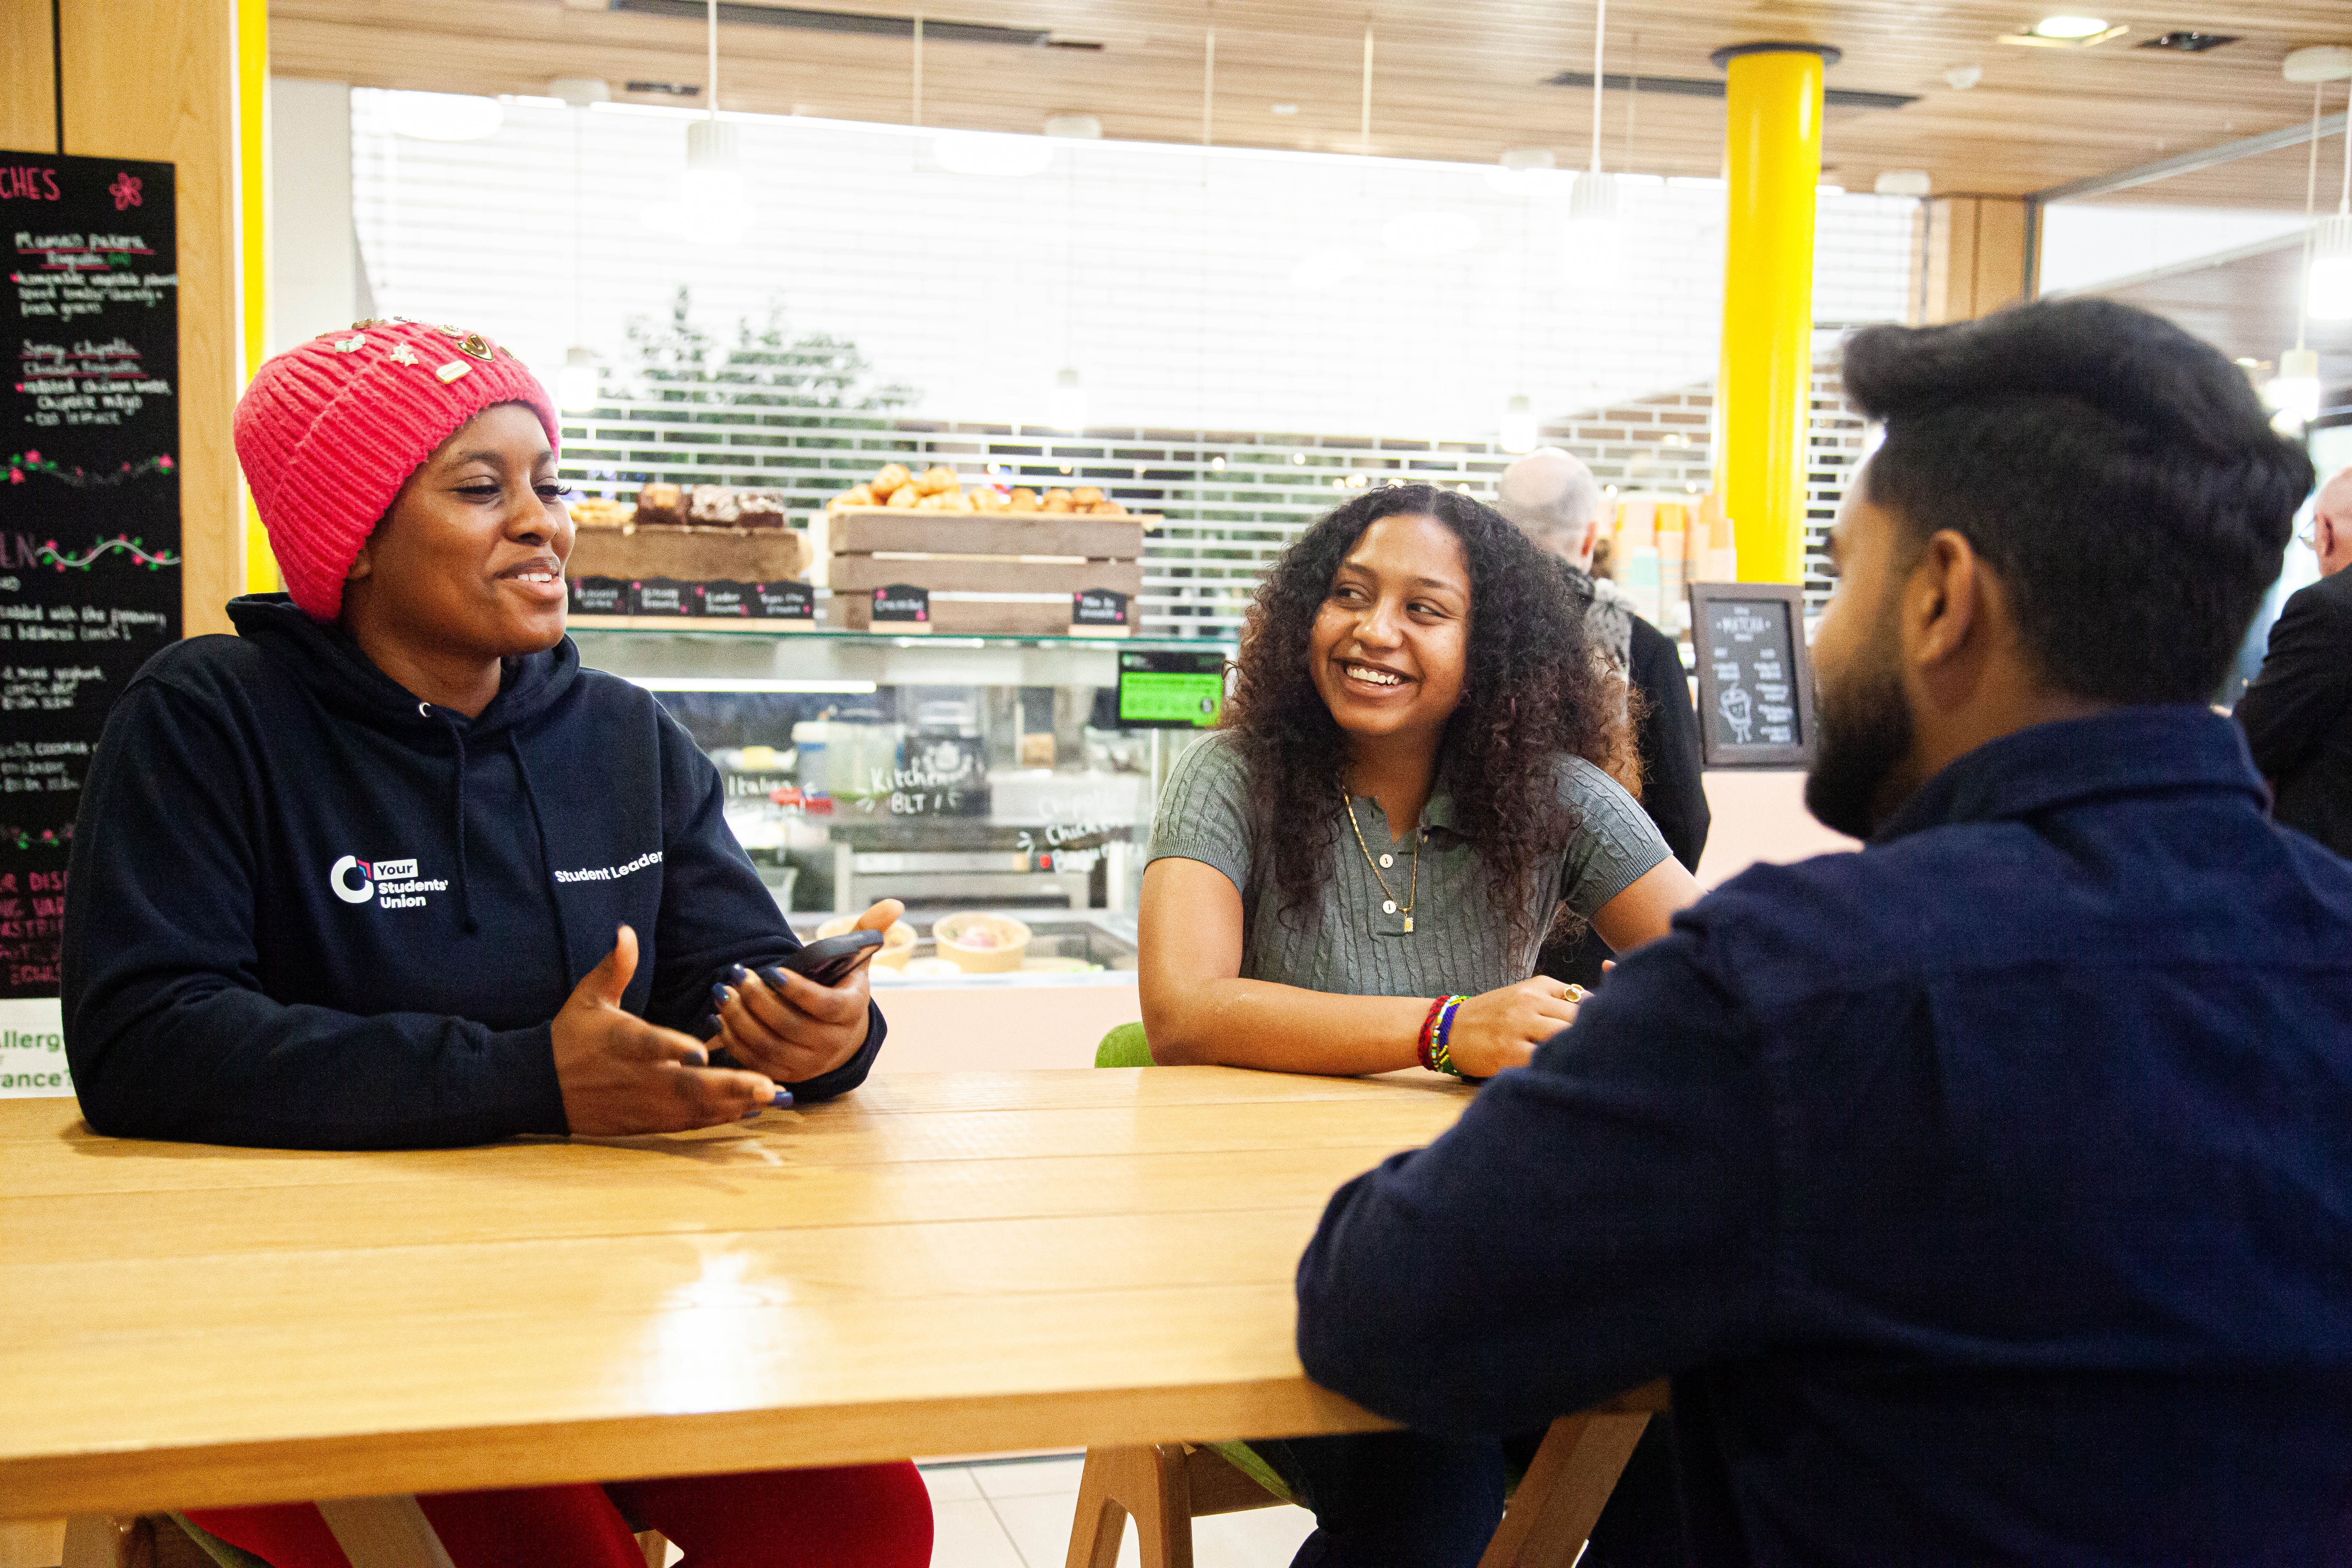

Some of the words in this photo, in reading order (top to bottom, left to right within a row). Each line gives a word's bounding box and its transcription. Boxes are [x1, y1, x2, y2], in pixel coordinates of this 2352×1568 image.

[377, 862, 413, 876] Your
[554, 867, 610, 883] Student
[610, 851, 663, 878] Leader
[378, 879, 449, 895] Students'
[380, 895, 426, 908] Union
[0, 1029, 60, 1053] llerg
